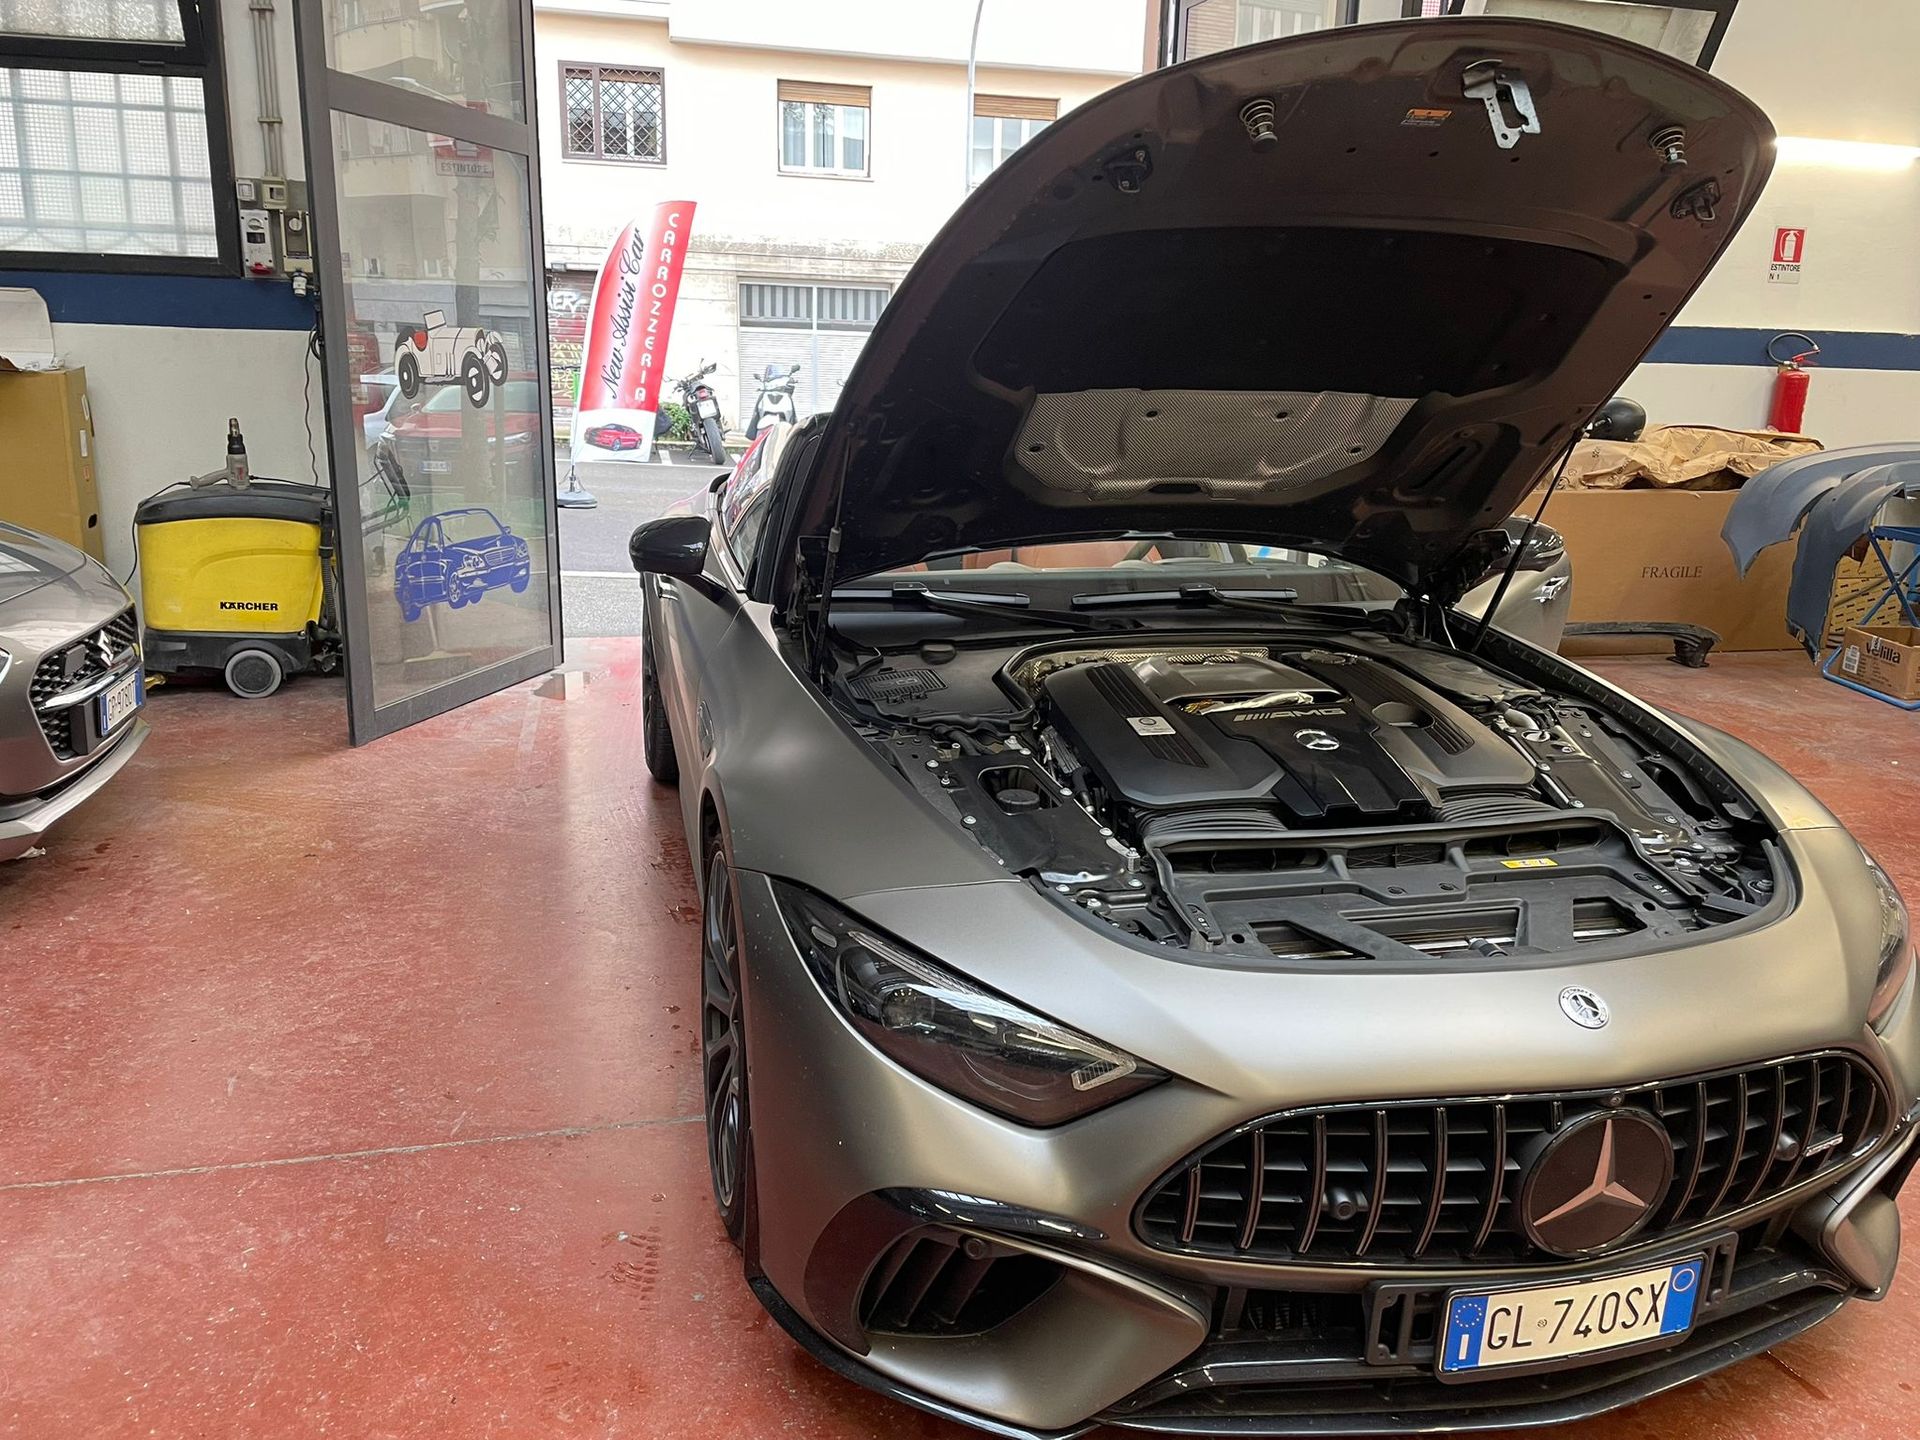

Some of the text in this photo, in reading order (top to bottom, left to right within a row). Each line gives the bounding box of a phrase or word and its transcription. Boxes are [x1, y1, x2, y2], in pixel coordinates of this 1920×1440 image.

[1770, 263, 1801, 272] ESTINTORE
[600, 227, 644, 400] New Assisi Car
[635, 212, 681, 402] CARROZZERIA
[1641, 565, 1703, 578] FRAGILE
[1269, 707, 1347, 719] AMG
[1486, 1304, 1533, 1351] GL
[1548, 1280, 1667, 1344] 740SX
